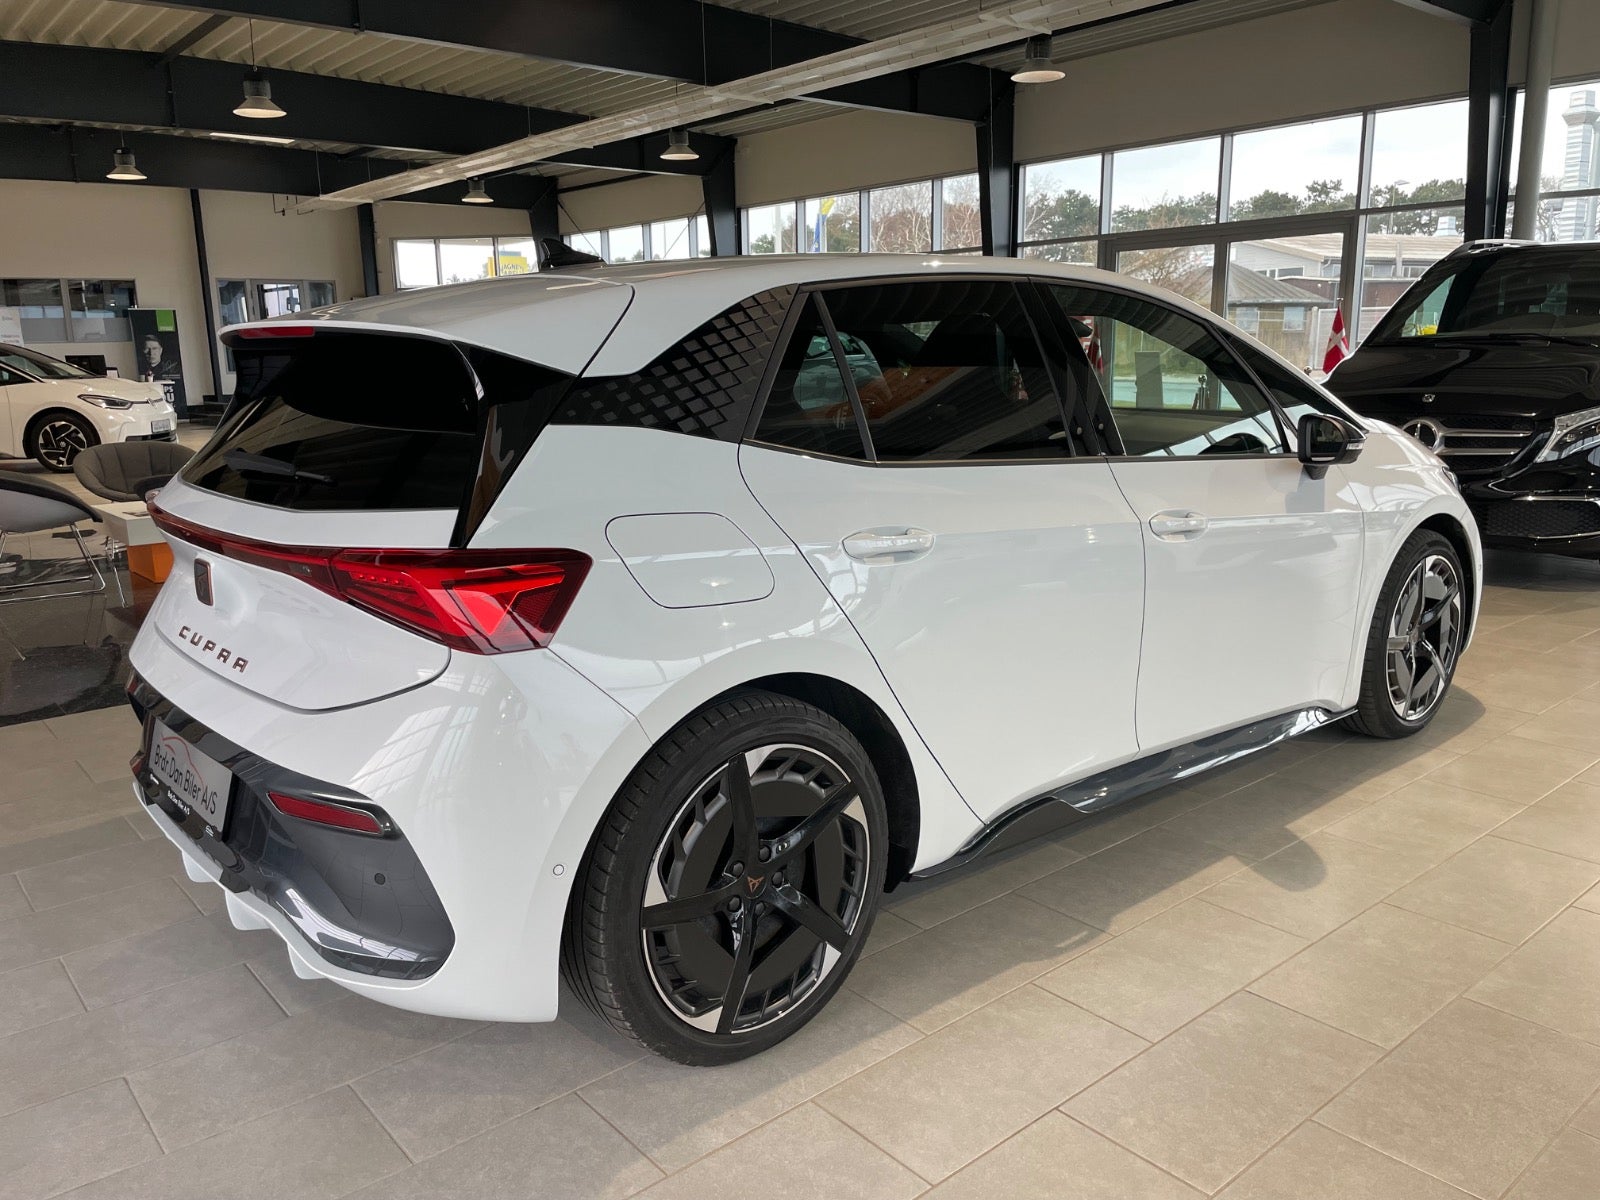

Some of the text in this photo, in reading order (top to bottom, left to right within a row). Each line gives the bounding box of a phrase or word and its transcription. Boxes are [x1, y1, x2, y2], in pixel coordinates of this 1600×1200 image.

[179, 625, 249, 673] CUPRA
[183, 769, 201, 800] Biler
[201, 785, 218, 814] A/S
